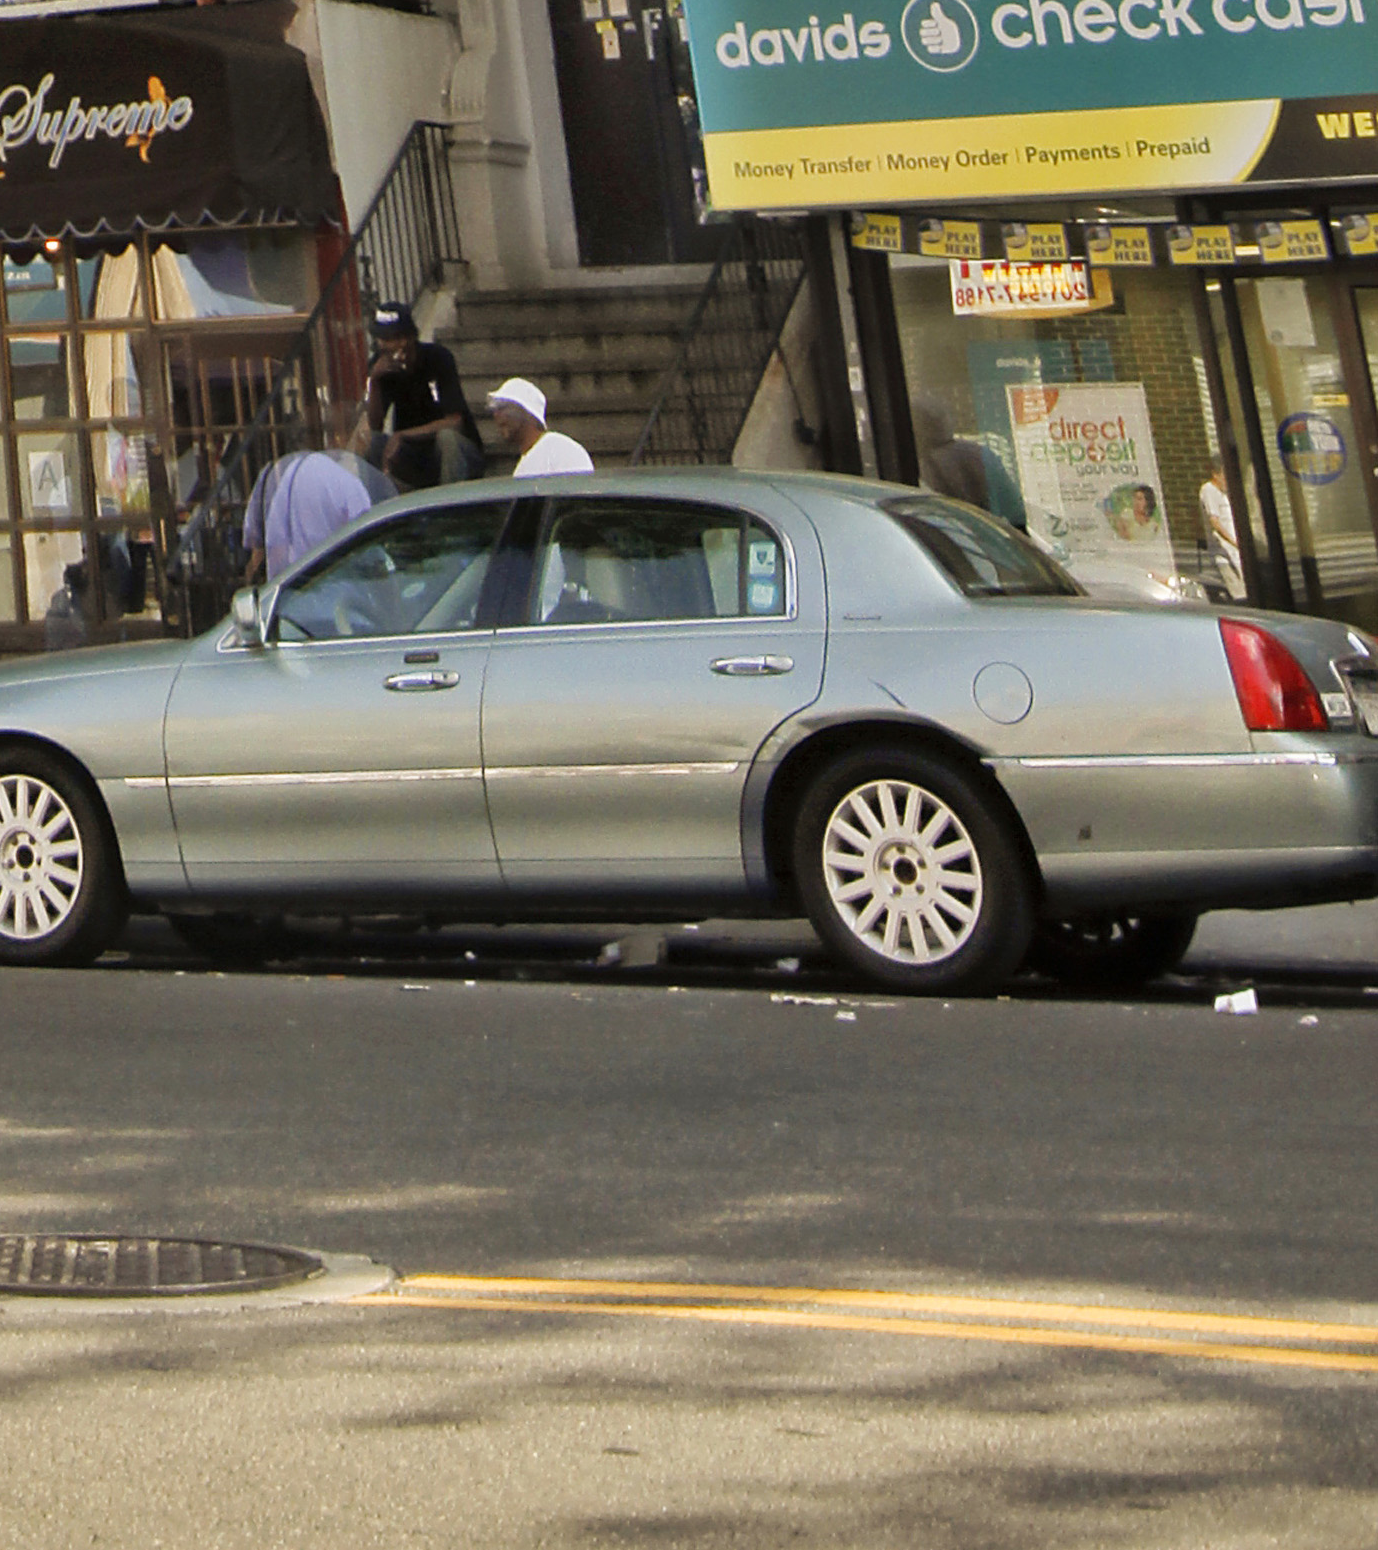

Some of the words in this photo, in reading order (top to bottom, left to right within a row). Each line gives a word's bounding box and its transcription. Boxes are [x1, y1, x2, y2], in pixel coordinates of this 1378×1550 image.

[716, 13, 892, 69] davids
[1317, 111, 1378, 140] WE
[734, 161, 795, 180] Money
[800, 157, 871, 175] Transfer
[887, 153, 950, 172] Money
[955, 149, 1008, 166] Order
[1025, 143, 1121, 166] Payments
[1136, 136, 1212, 160] Prepaid
[1048, 415, 1126, 442] direct
[38, 460, 59, 491] A
[1076, 464, 1107, 477] your
[1111, 463, 1139, 477] way
